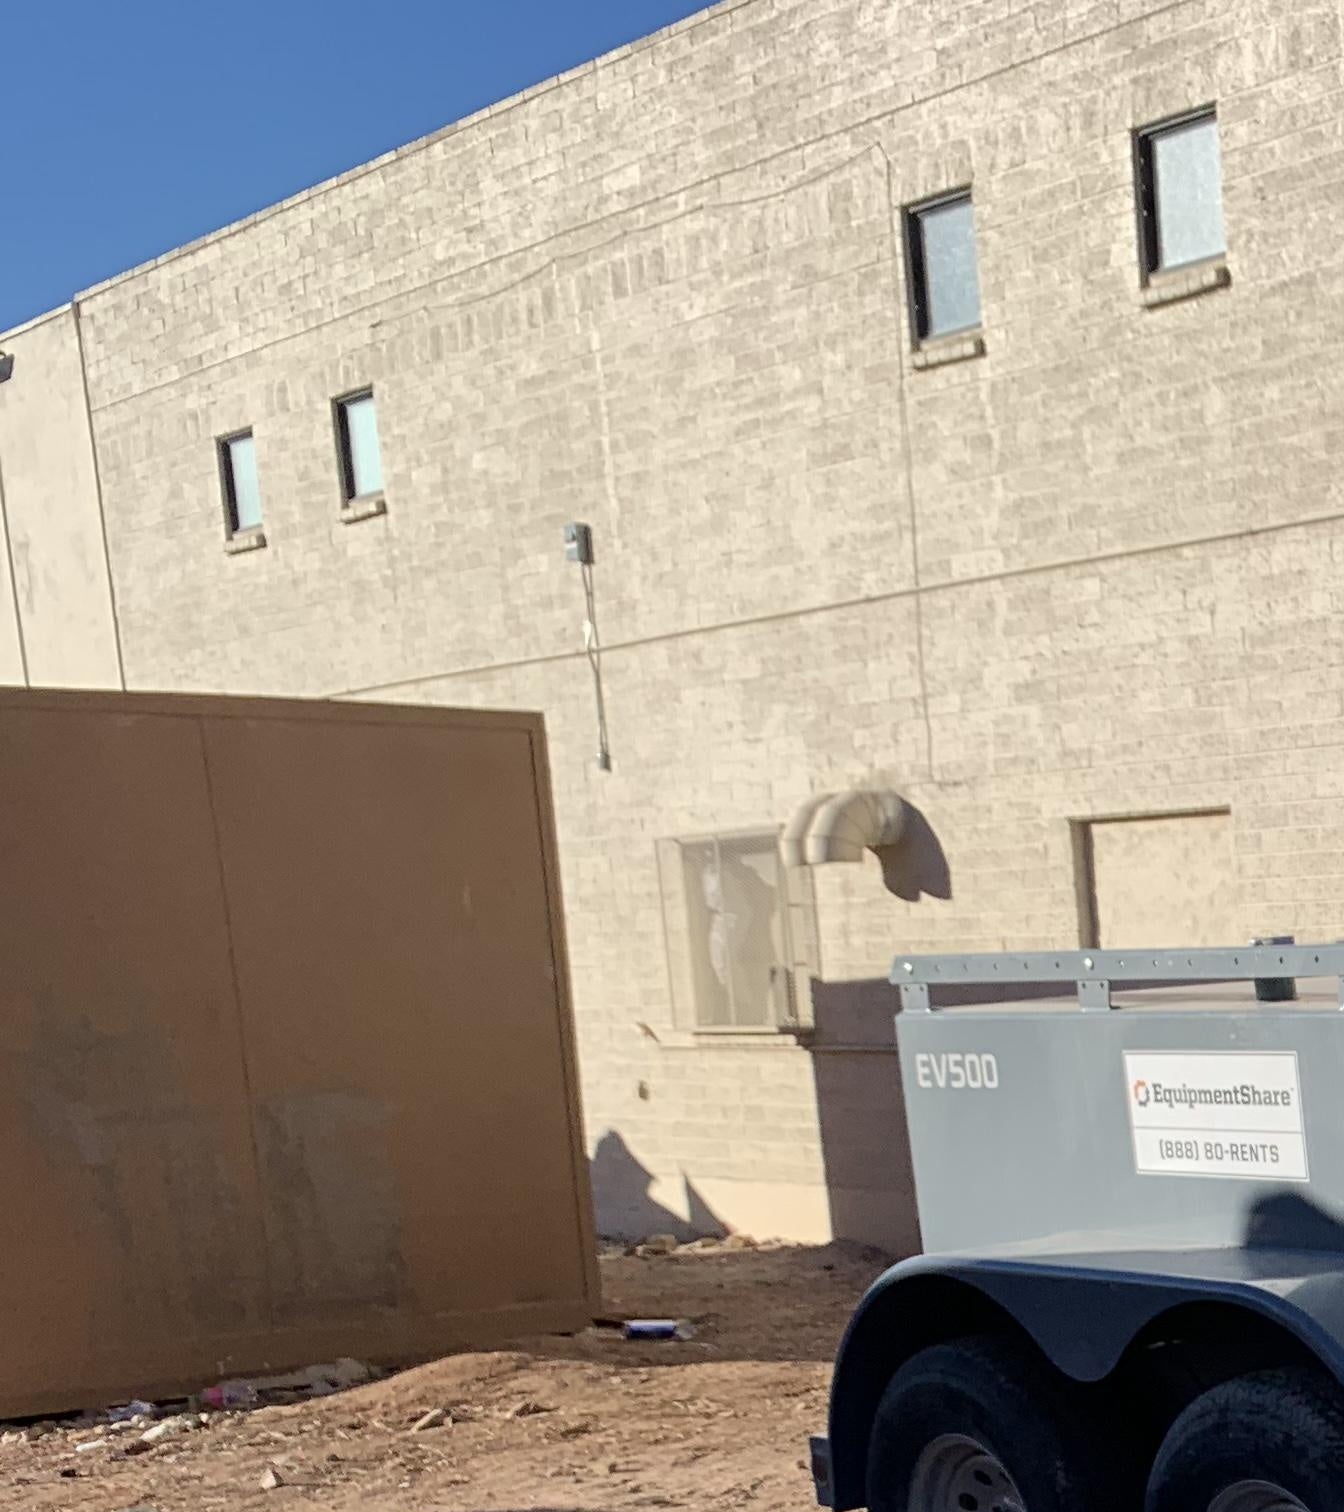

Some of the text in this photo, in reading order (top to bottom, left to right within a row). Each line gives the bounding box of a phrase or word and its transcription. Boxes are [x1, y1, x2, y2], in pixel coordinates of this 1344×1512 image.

[915, 1053, 999, 1088] EV500
[1152, 1083, 1291, 1109] EquipmentShare
[1159, 1139, 1280, 1163] (888) 80-RENTS
